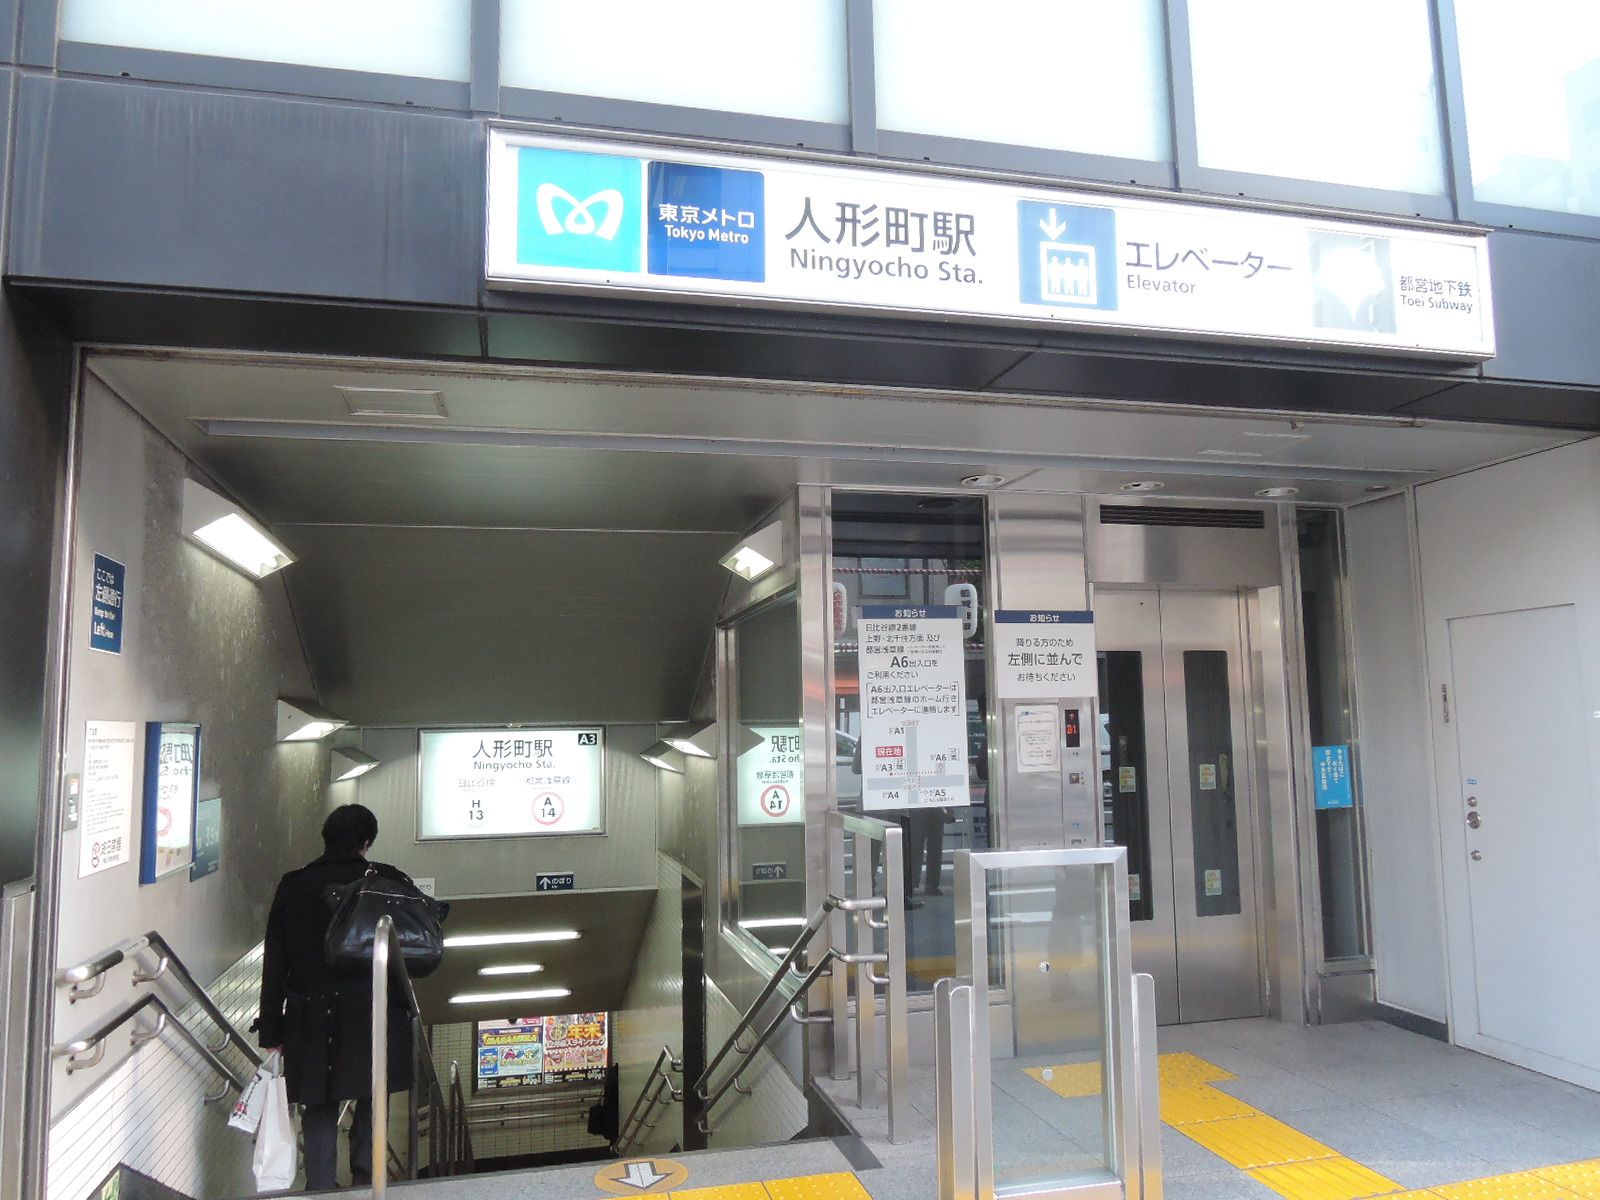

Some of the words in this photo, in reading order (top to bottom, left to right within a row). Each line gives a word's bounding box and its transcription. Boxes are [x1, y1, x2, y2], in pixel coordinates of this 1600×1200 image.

[658, 202, 756, 229] 東京メトロ
[784, 195, 977, 258] 人形町駅
[664, 224, 705, 242] Tokyo
[708, 226, 749, 245] Metro
[790, 247, 929, 280] Ningyocho
[938, 262, 983, 284] Sta.
[1126, 240, 1293, 280] エレベーター
[1127, 274, 1197, 295] Elevator
[1400, 274, 1473, 299] 都営地下鉄
[1400, 294, 1425, 308] Toei
[1429, 296, 1474, 314] Subway
[894, 608, 927, 618] お知らせ
[1029, 613, 1060, 623] お知らせ
[1016, 637, 1074, 648] 降りる方のため
[1007, 652, 1083, 667] 左側に並んで
[866, 670, 919, 680] ご利用ください
[1017, 672, 1076, 682] お待ちください
[579, 734, 597, 745] A3
[472, 739, 553, 758] 人形町駅
[473, 760, 532, 772] Ningyocho
[535, 760, 556, 769] Sta.
[472, 800, 481, 808] H
[543, 797, 552, 806] A
[469, 810, 484, 821] 13
[541, 808, 556, 818] 14
